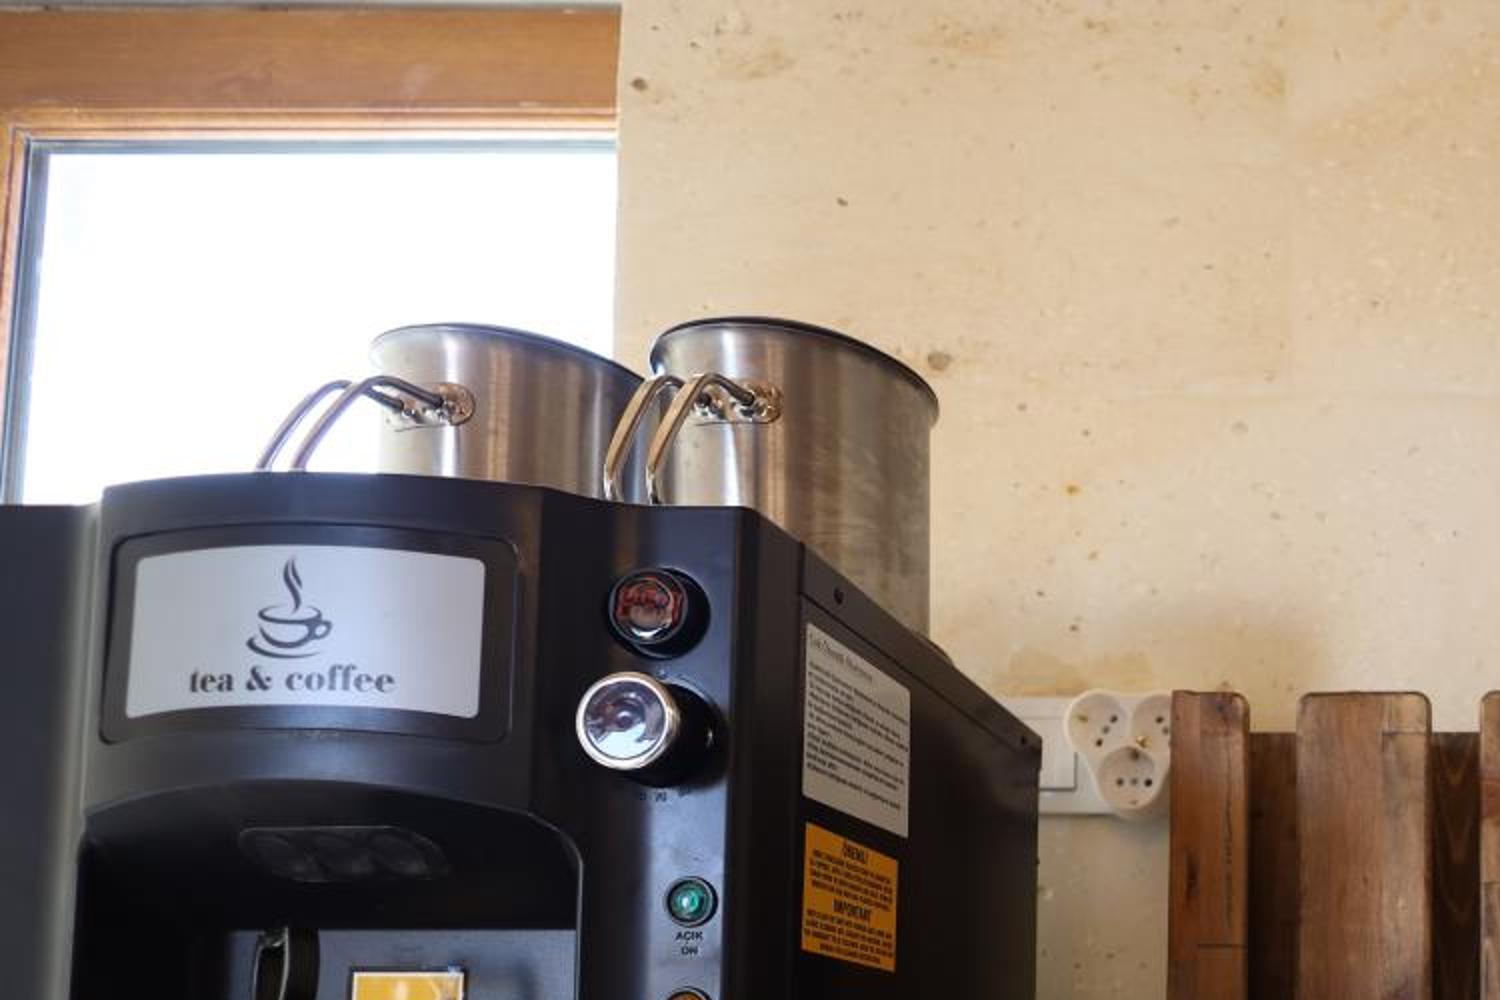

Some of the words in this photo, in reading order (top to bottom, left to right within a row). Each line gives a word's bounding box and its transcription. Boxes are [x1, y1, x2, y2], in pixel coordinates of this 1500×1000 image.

[189, 670, 234, 693] tea
[245, 666, 272, 692] &
[285, 664, 396, 693] coffee
